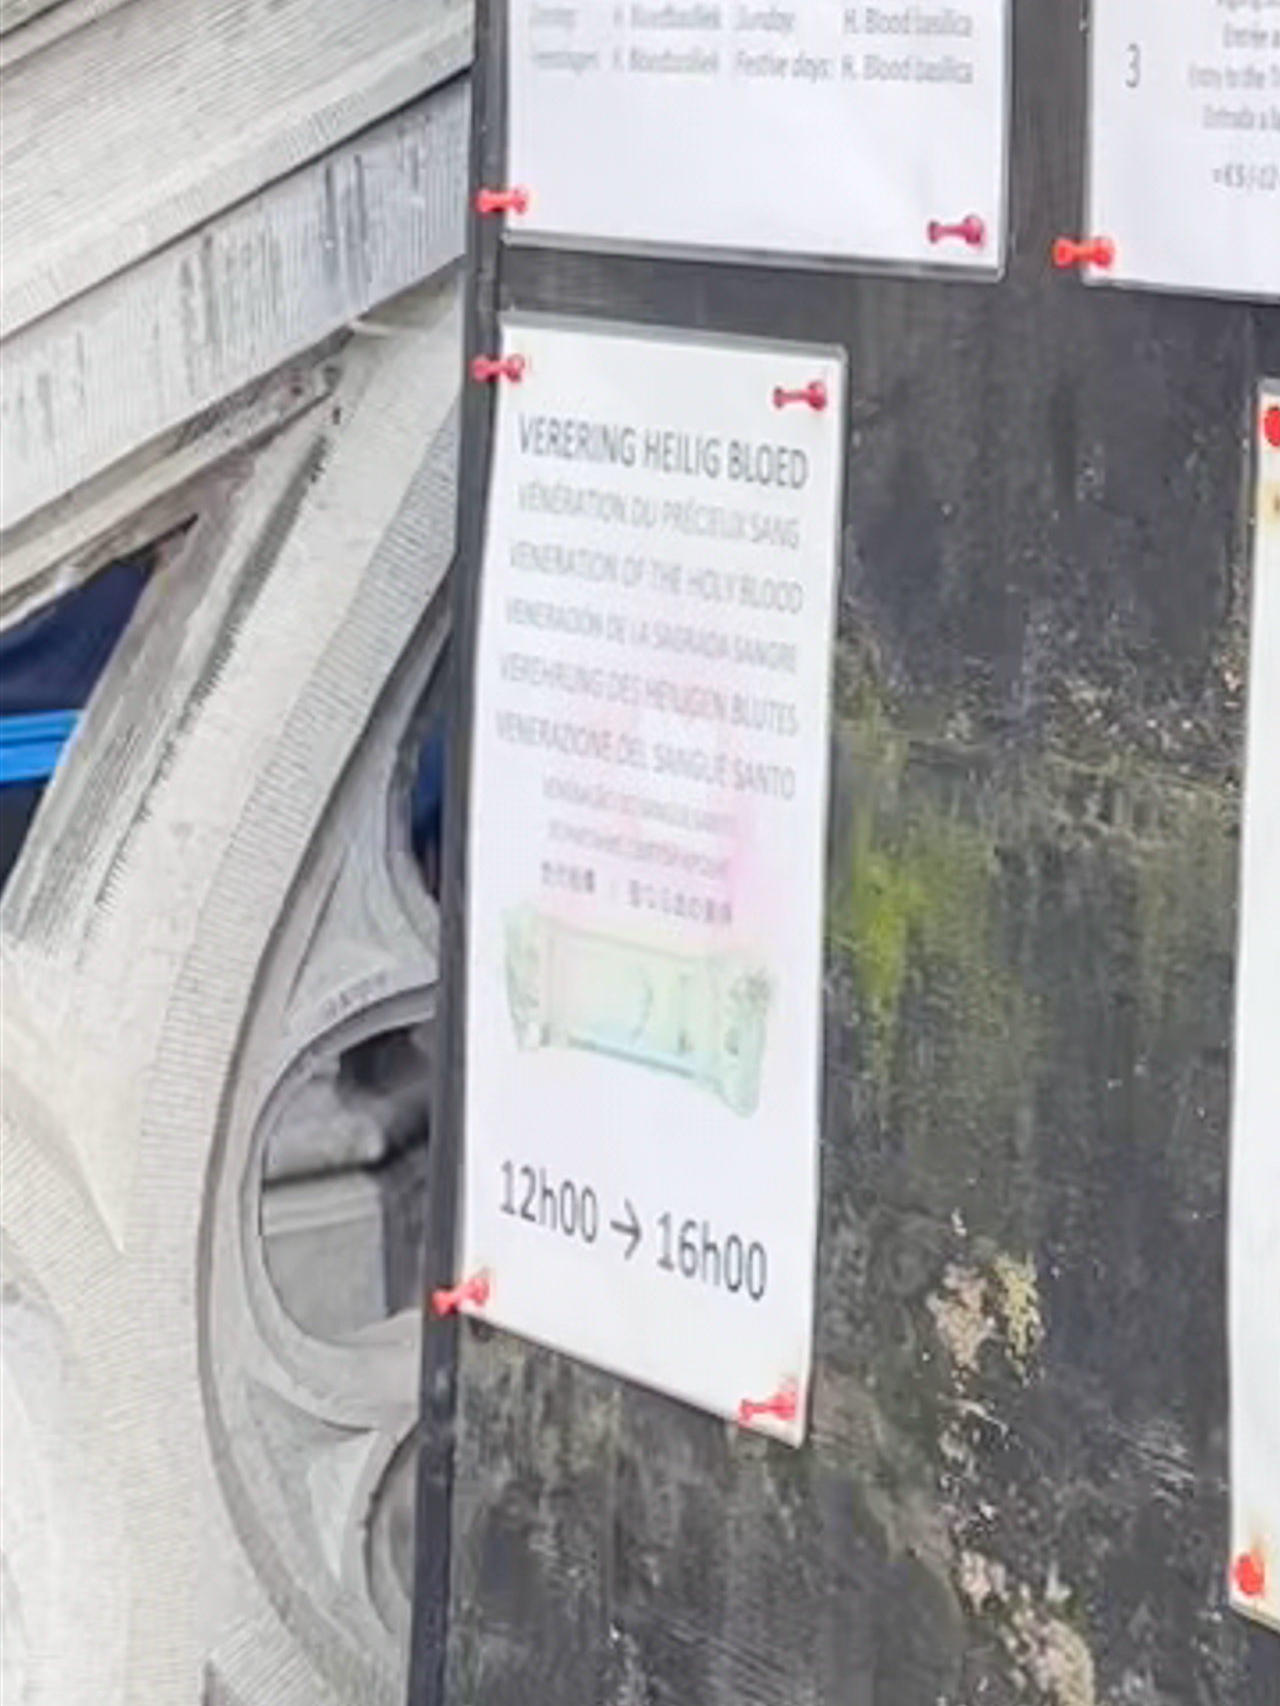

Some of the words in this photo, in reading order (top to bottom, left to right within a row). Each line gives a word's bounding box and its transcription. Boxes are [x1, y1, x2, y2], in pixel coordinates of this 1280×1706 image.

[519, 416, 635, 467] VERERING
[642, 430, 721, 479] HEILIG
[727, 440, 807, 489] BLOED
[748, 512, 800, 550] SANG
[651, 559, 682, 595] THE
[738, 574, 803, 614] BLOOD
[729, 692, 799, 737] BLUTES
[731, 756, 795, 800] SANTO
[501, 1161, 597, 1243] 12h00
[657, 1213, 767, 1300] 16h00
